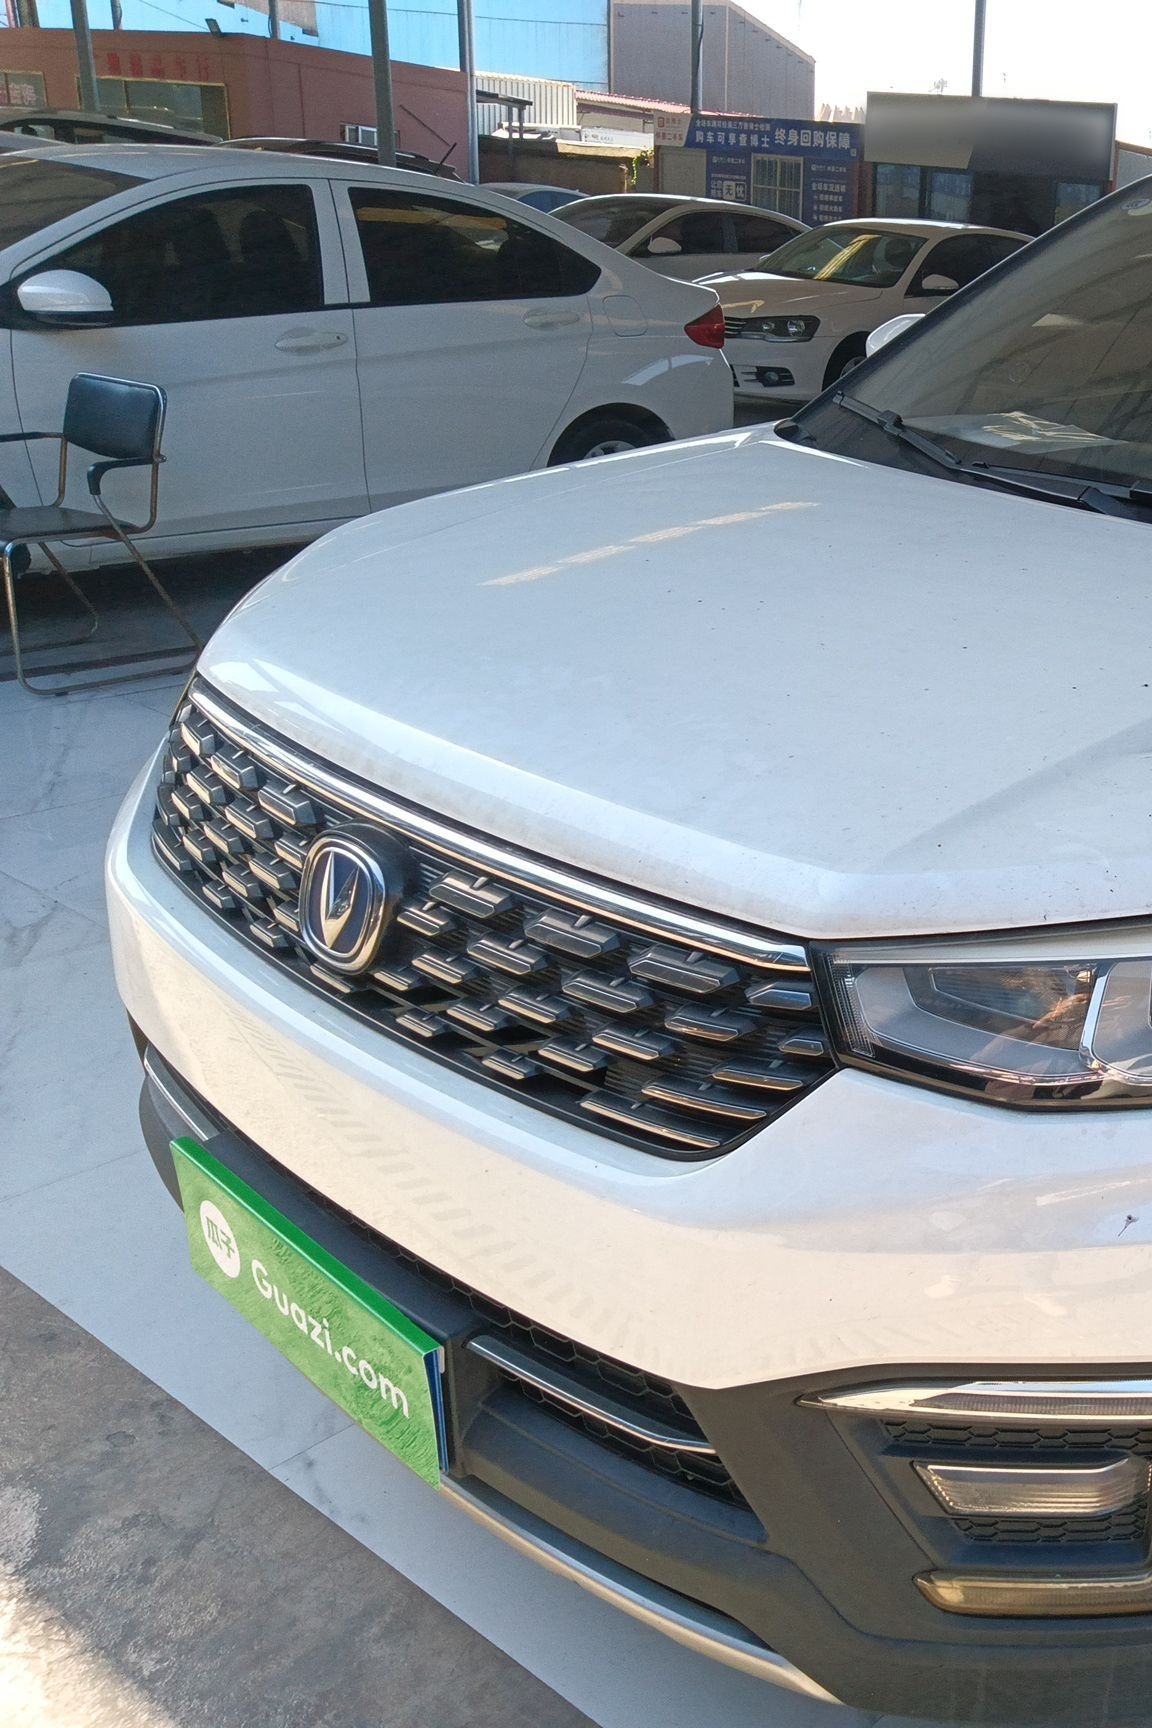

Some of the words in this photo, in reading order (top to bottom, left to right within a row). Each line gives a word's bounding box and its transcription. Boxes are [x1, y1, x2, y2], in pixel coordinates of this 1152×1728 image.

[695, 130, 770, 148] 购车可享查博士
[774, 128, 850, 150] 终身回购保障
[206, 1216, 235, 1258] 瓜子
[251, 1259, 410, 1419] Guazi.com
